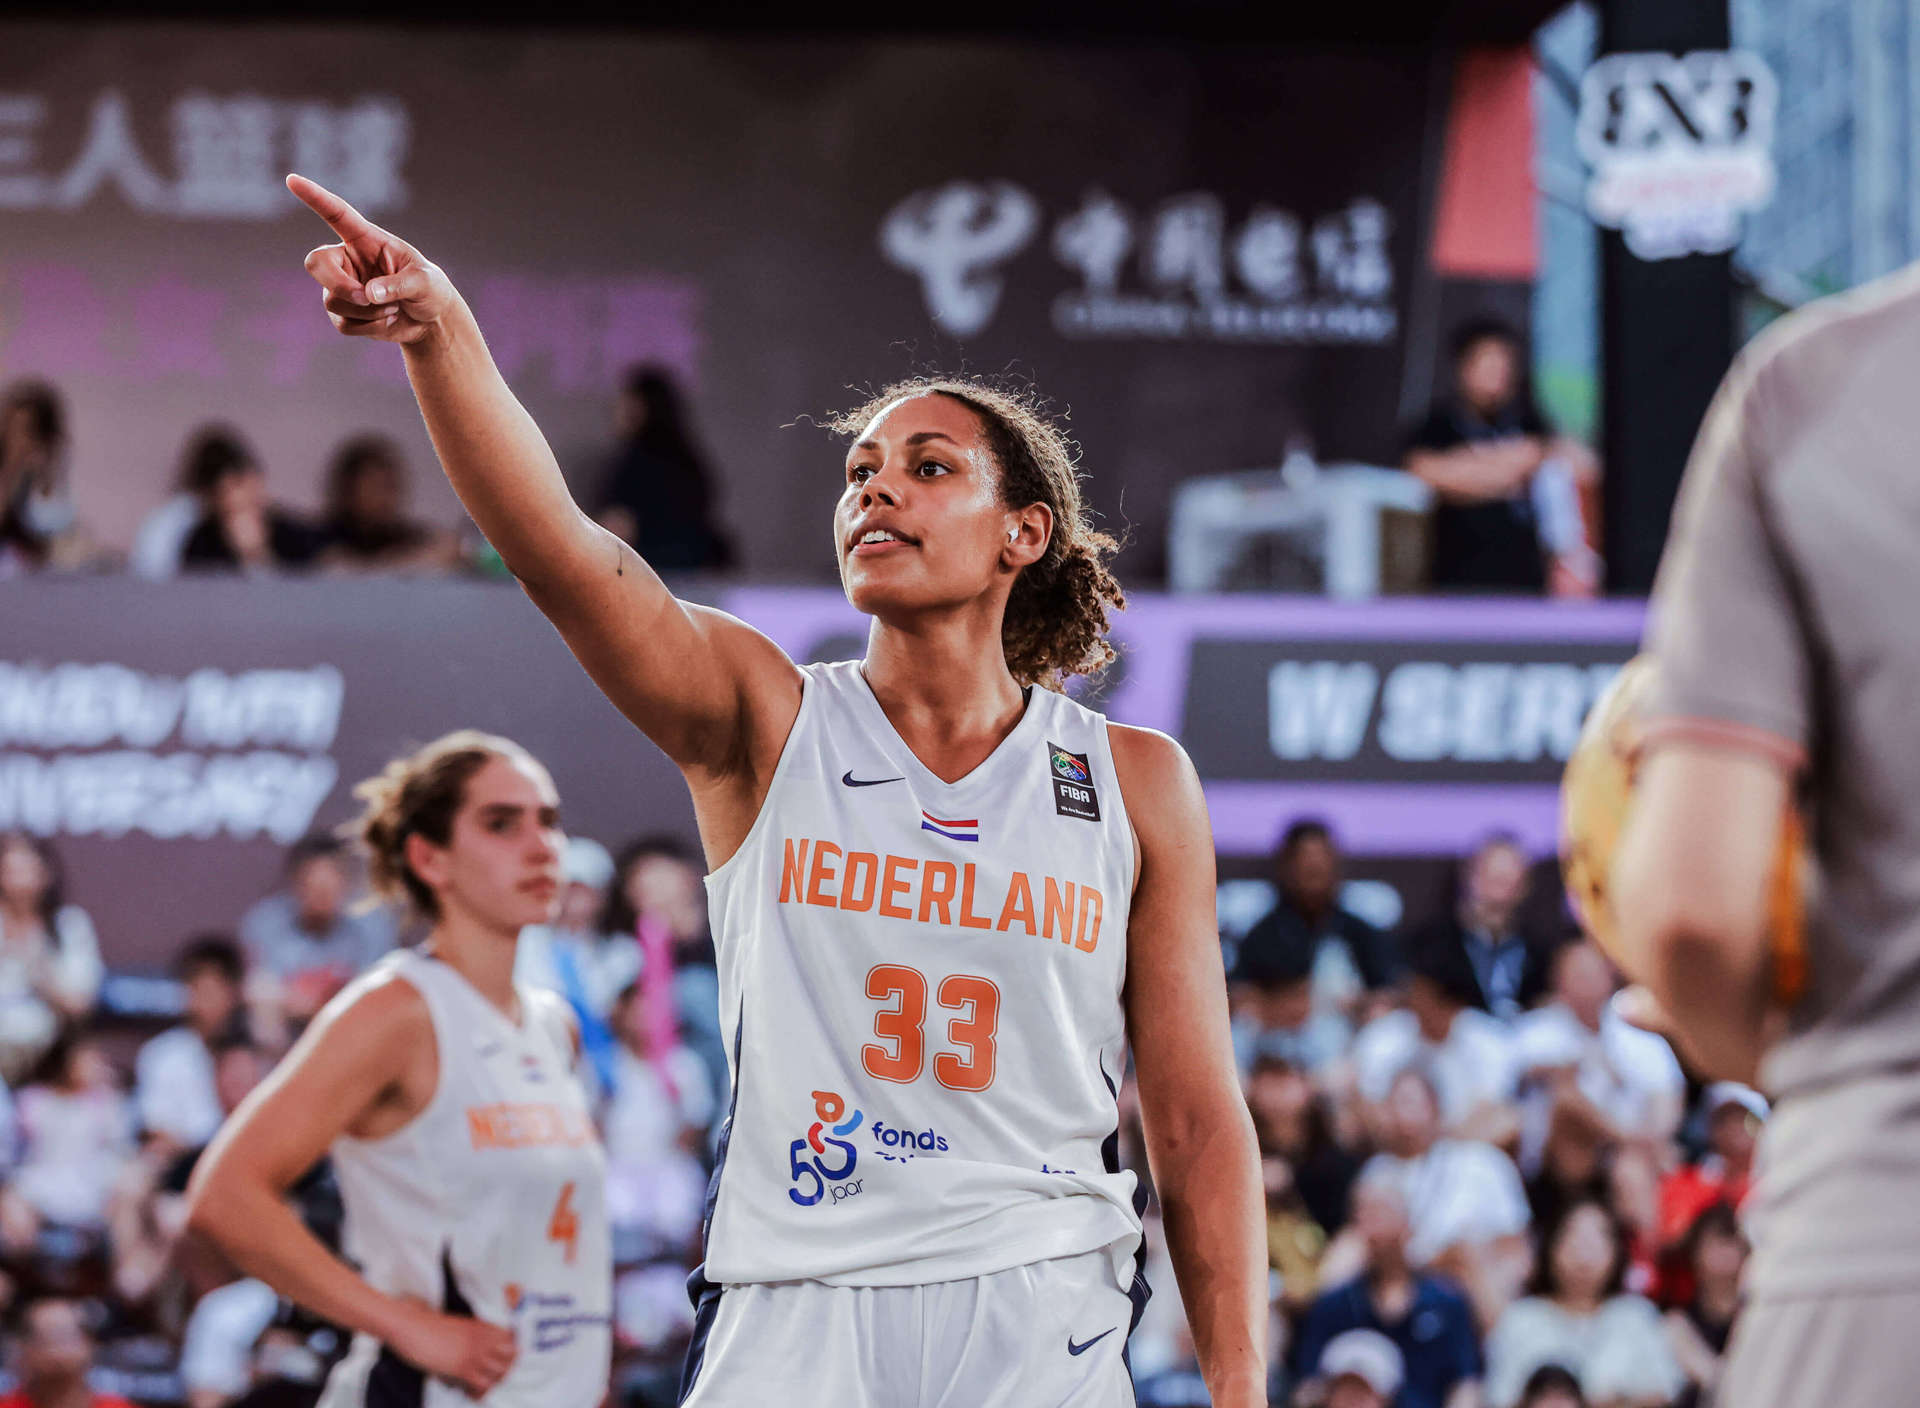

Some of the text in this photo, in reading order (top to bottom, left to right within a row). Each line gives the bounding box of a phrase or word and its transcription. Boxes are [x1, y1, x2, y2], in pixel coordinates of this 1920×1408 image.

[1268, 661, 1622, 761] W SER
[1060, 784, 1090, 803] FIBA
[779, 838, 1103, 953] NEDERLAND
[861, 963, 1000, 1092] 33
[872, 1121, 949, 1151] fonds
[546, 1180, 580, 1265] 4
[830, 1178, 864, 1205] jaar
